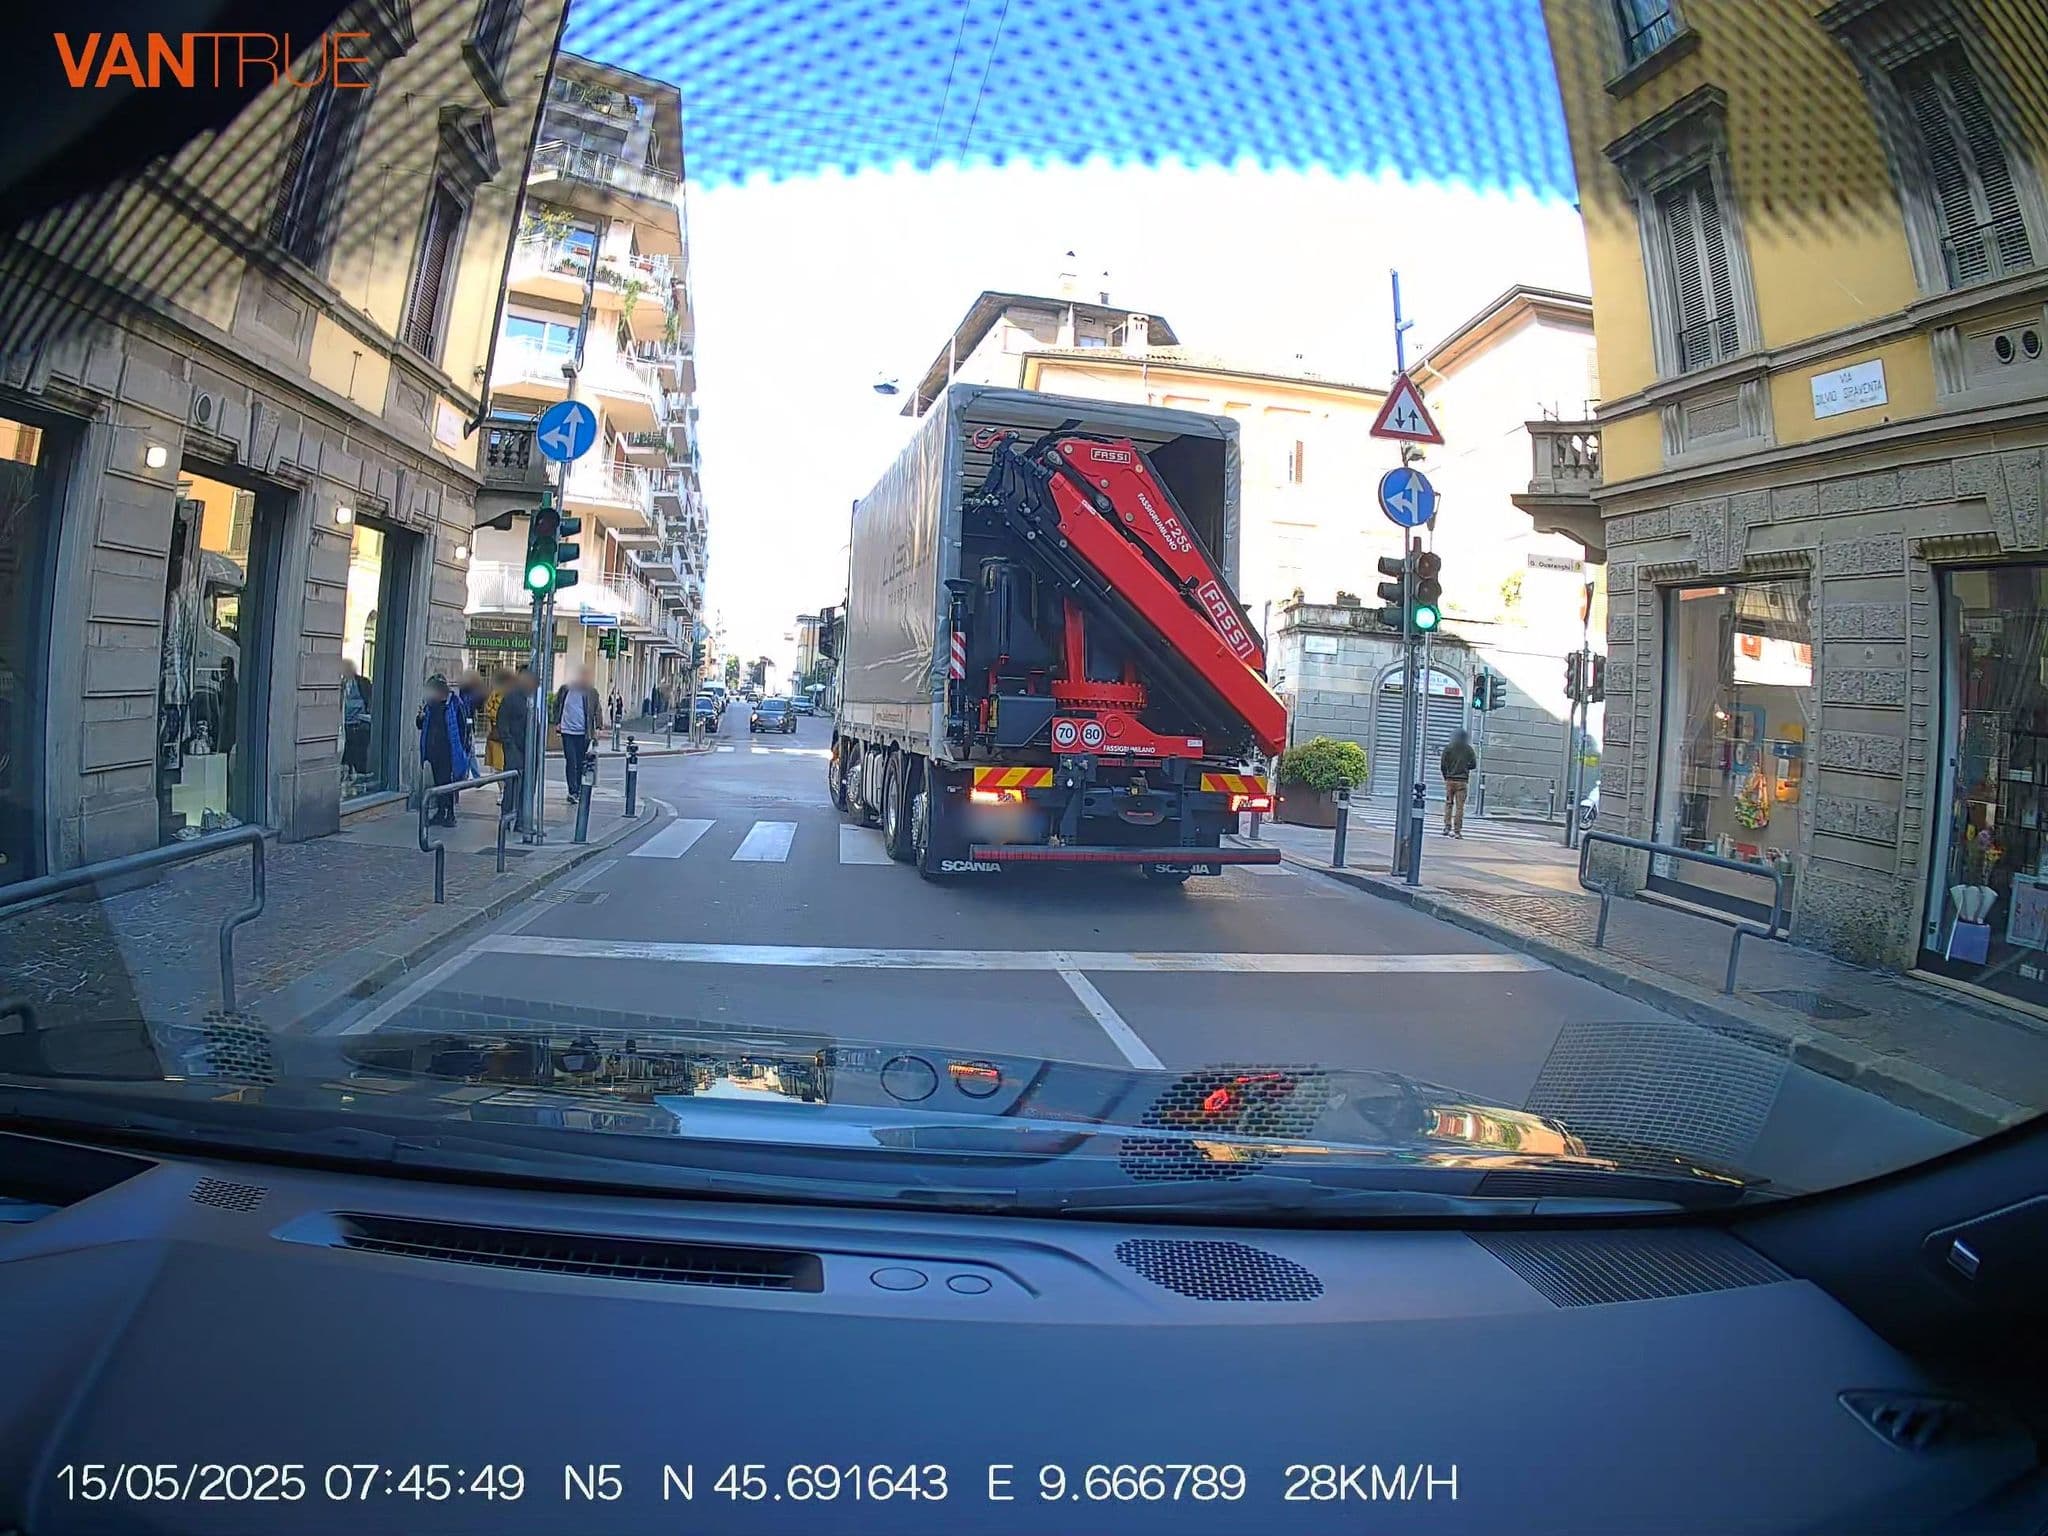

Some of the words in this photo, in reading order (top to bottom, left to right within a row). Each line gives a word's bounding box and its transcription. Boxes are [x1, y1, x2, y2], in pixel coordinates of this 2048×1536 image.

[1843, 380, 1883, 399] SPAVENTA
[1093, 450, 1128, 461] FASSI
[1204, 589, 1249, 651] FASSI
[1059, 727, 1073, 739] 70
[1085, 728, 1100, 740] 80
[941, 859, 1002, 872] SCANIA
[1154, 863, 1211, 875] SCIA
